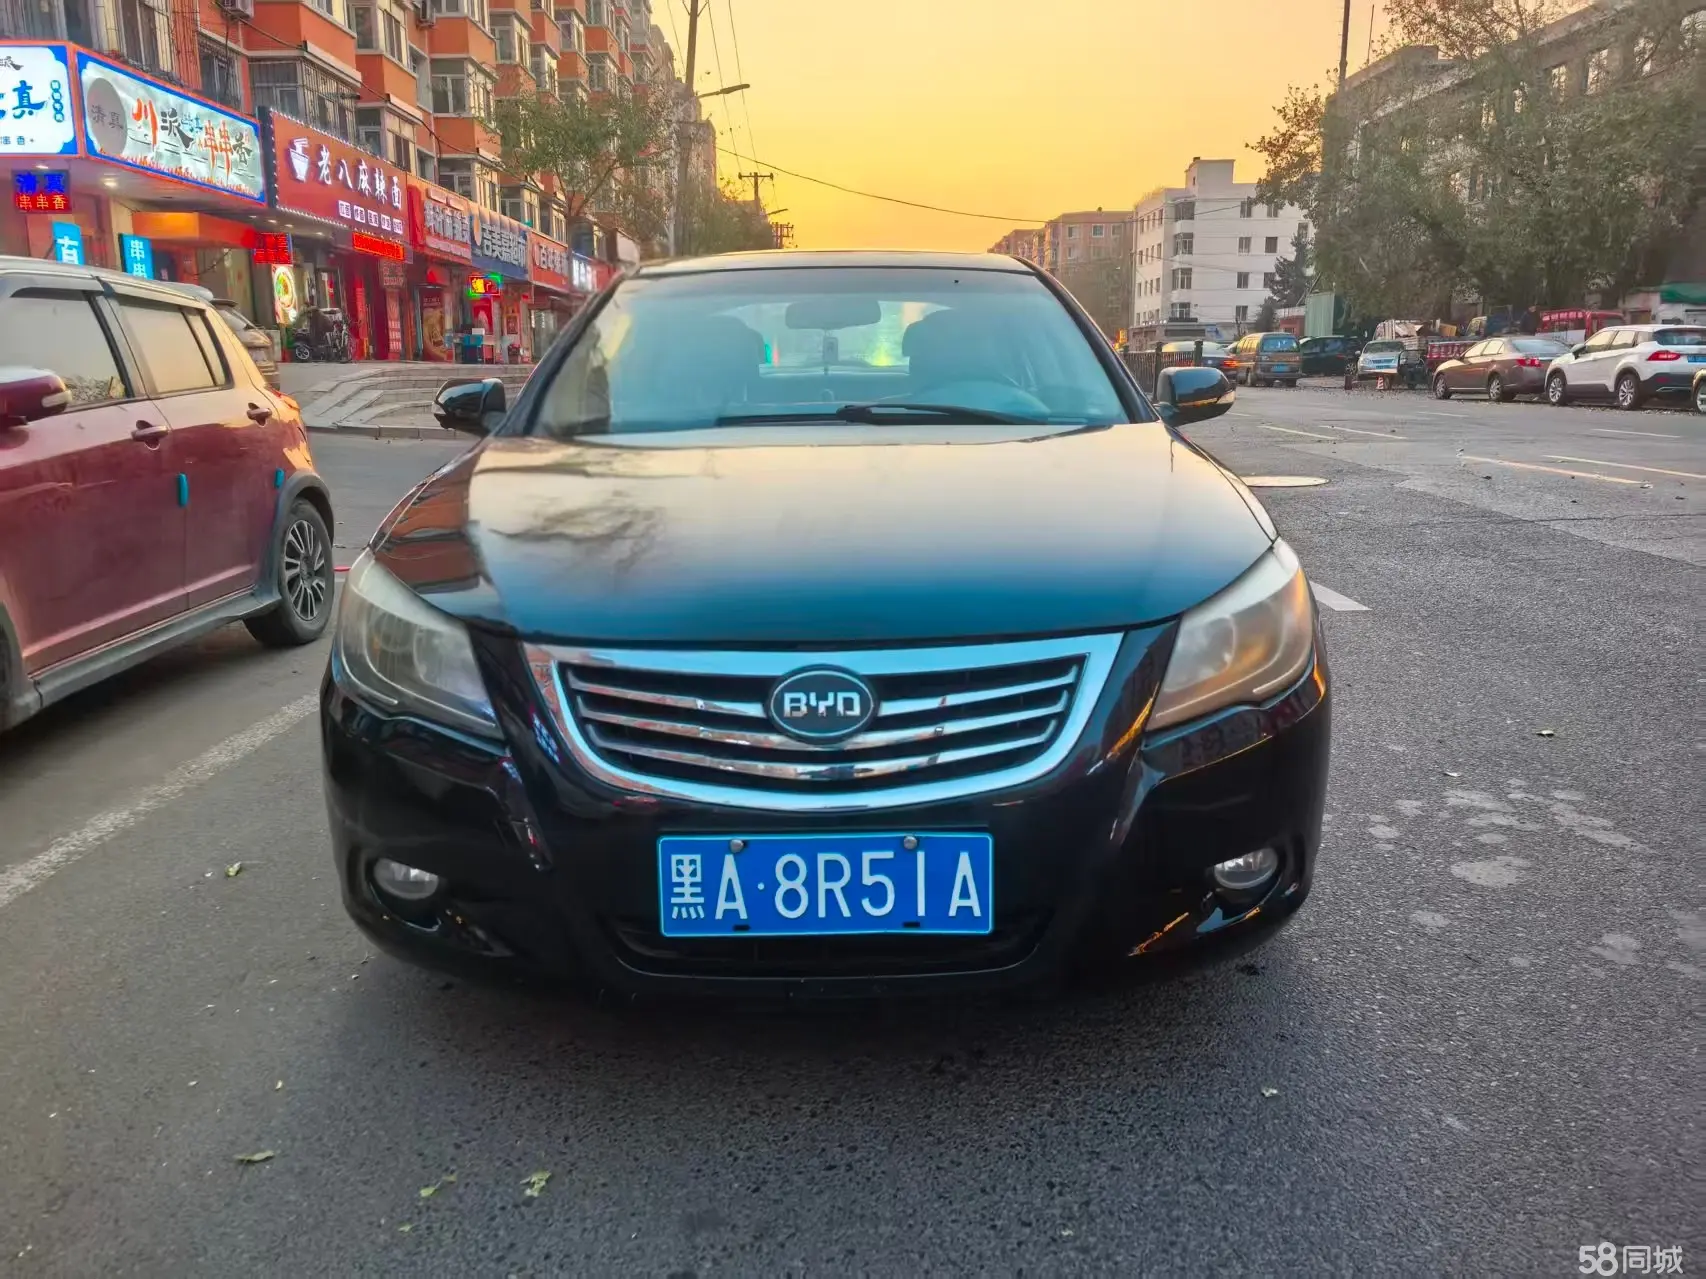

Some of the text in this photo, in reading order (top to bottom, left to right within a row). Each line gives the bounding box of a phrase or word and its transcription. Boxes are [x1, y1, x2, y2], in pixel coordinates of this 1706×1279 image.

[318, 144, 402, 211] 老八麻辣面
[18, 193, 68, 210] 串串香
[783, 691, 861, 717] BYD
